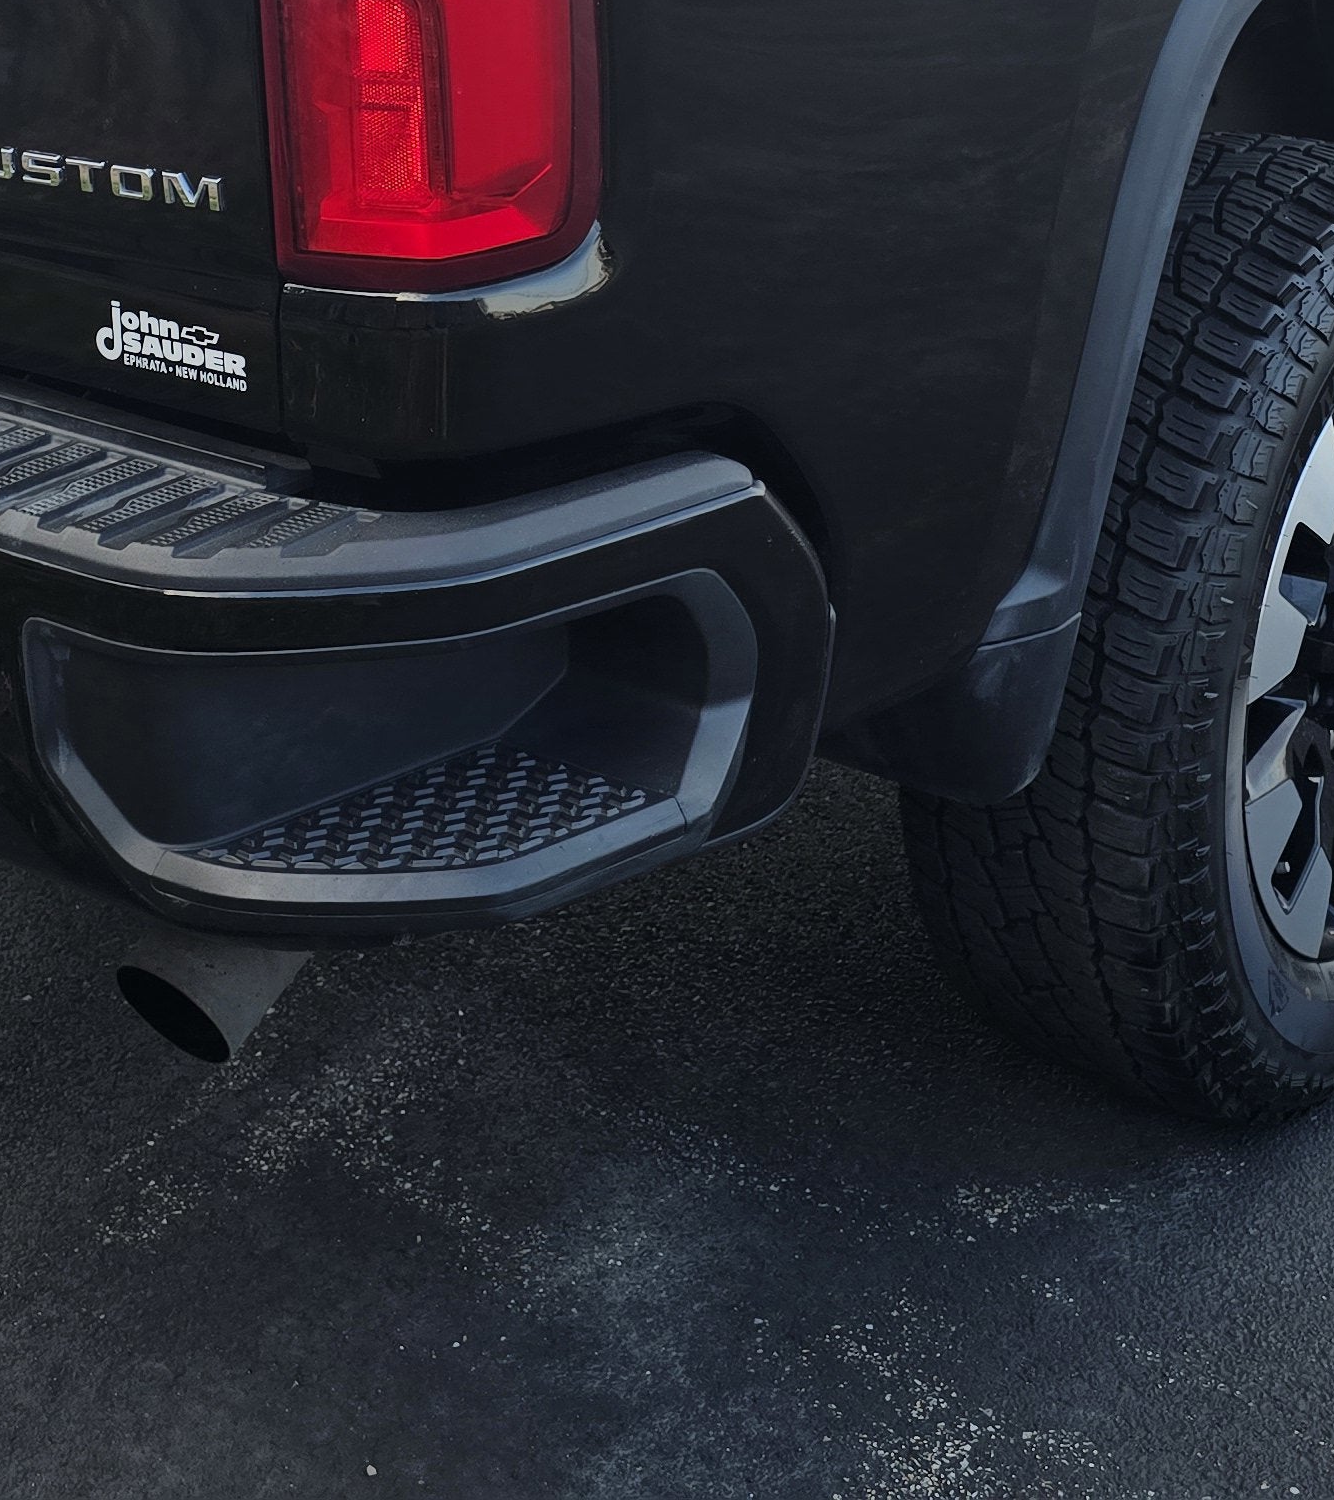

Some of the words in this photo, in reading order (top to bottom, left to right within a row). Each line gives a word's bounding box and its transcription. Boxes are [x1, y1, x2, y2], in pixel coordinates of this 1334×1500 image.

[122, 331, 247, 378] SAUDER
[123, 353, 168, 375] EPHRATA
[175, 364, 198, 382] NEW
[199, 370, 248, 393] HOLLAND
